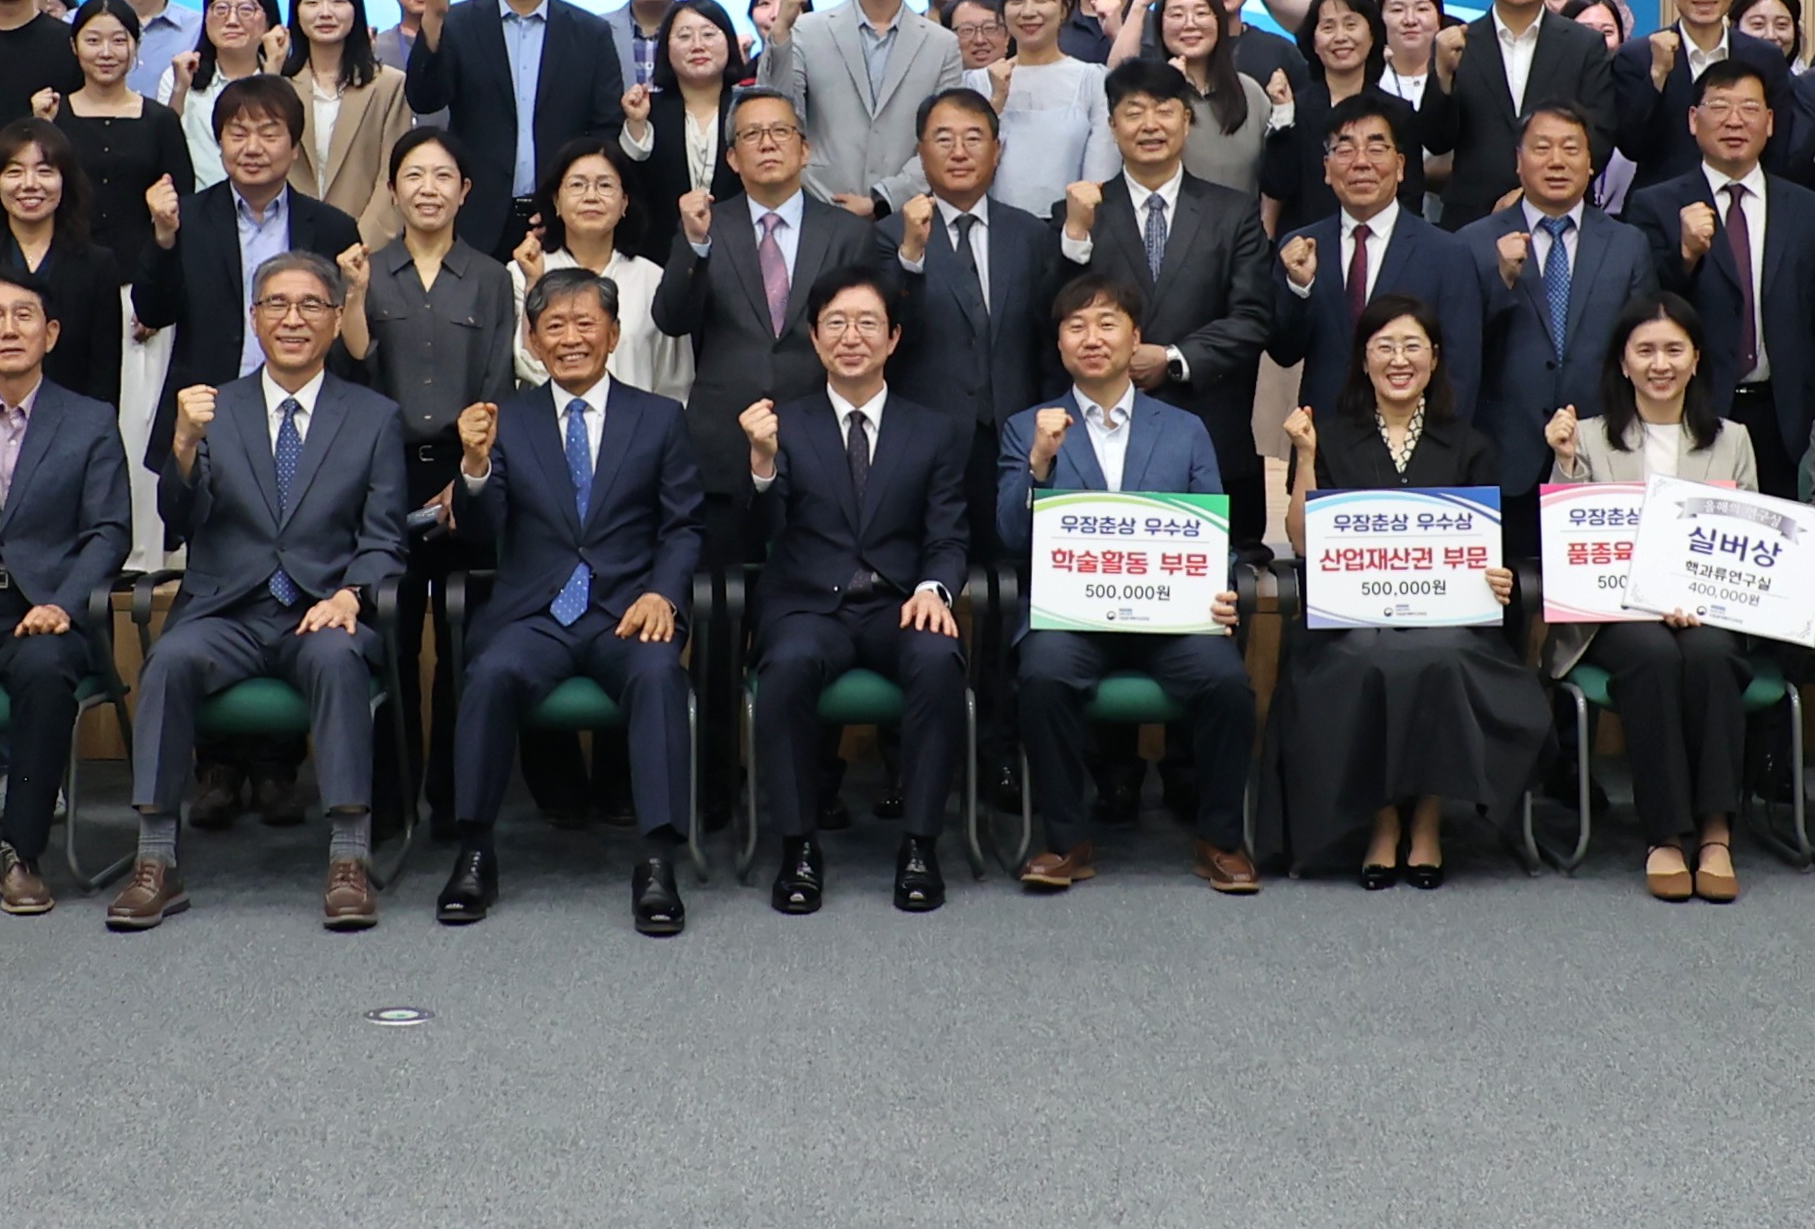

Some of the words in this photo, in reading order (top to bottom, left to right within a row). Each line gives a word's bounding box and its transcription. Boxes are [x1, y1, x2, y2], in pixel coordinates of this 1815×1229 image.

[1060, 515, 1136, 535] 우장춘상
[1144, 518, 1201, 537] 우수상
[1333, 513, 1408, 532] 우장춘상
[1416, 512, 1473, 531] 우수상
[1319, 547, 1433, 571] 산업재산권
[1443, 546, 1488, 570] 부문
[1688, 526, 1783, 568] 실버상
[1051, 548, 1149, 575] 학술활동
[1160, 553, 1209, 577] 부문
[1361, 580, 1446, 596] 500,000원
[1685, 560, 1772, 591] 핵과류연구실
[1085, 584, 1171, 601] 500,000원
[1688, 582, 1761, 607] 400,000원
